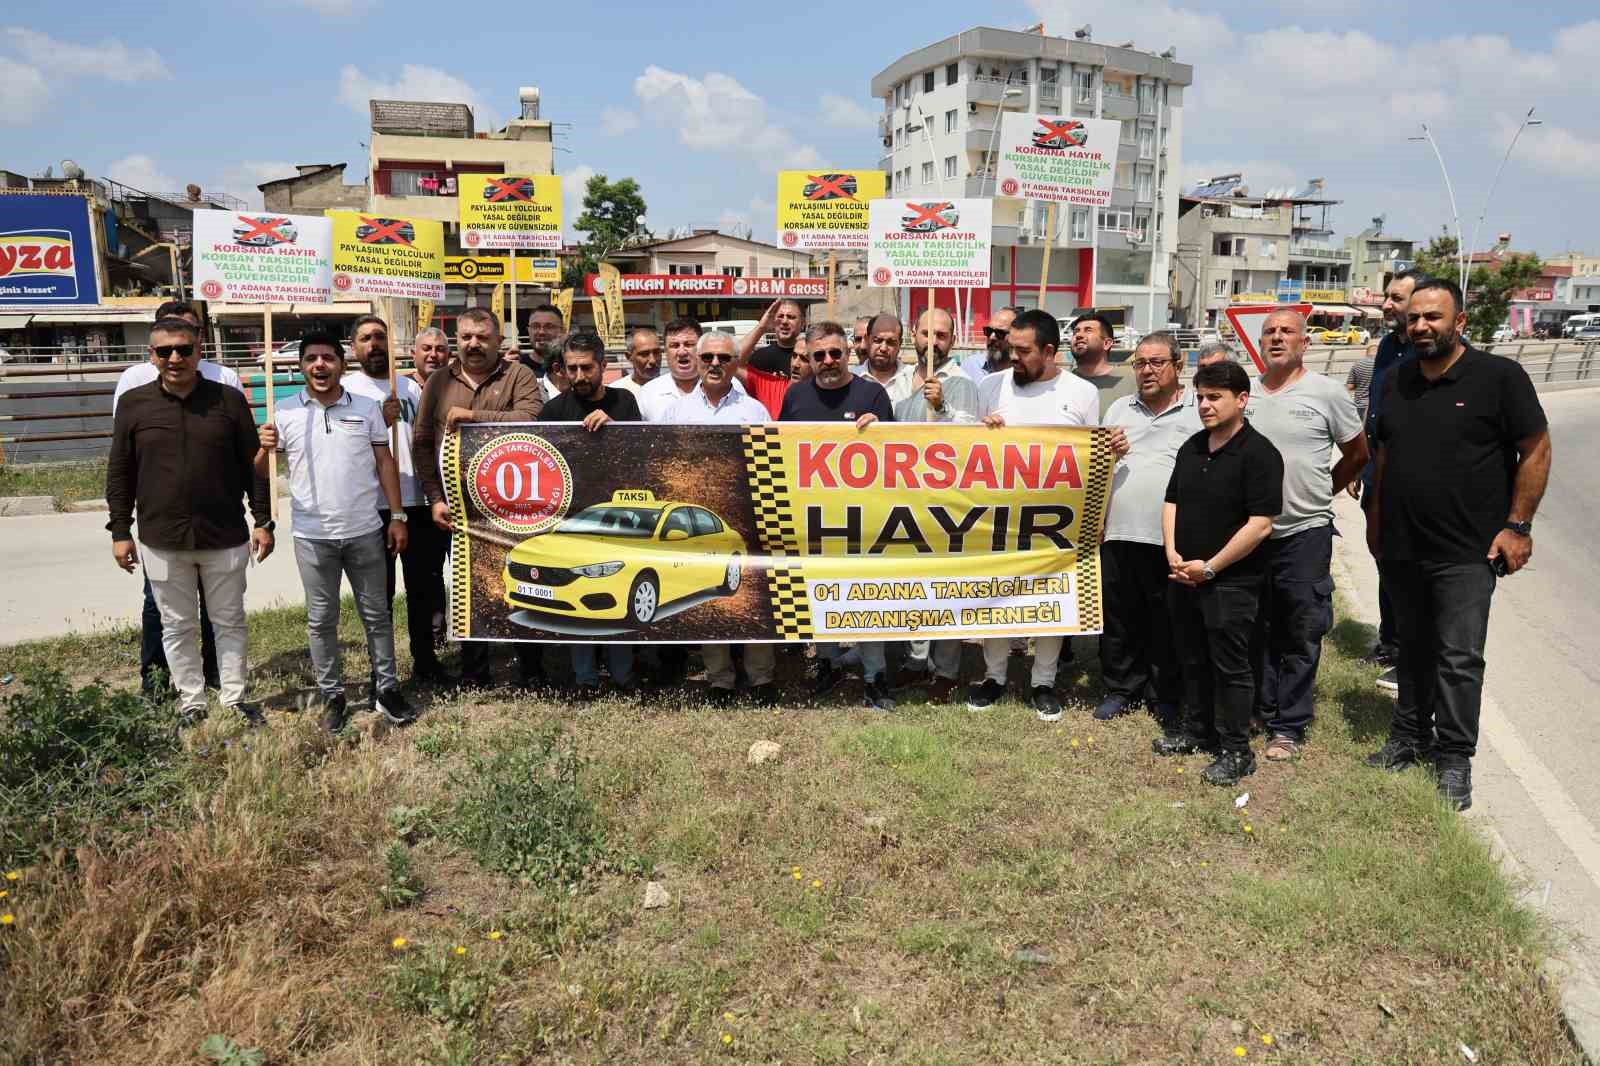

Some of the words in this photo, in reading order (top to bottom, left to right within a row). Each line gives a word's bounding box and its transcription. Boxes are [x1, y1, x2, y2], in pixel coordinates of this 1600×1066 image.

[1016, 146, 1065, 157] KORSANA
[1069, 151, 1102, 160] HAYIR
[1005, 154, 1047, 165] KORSAN
[1014, 163, 1045, 172] YASAL
[1034, 184, 1059, 193] ADANA
[829, 221, 869, 230] GÜVENSİZ
[214, 244, 274, 255] KORSANA
[280, 248, 316, 256] HAYIR
[340, 244, 389, 255] PAYLAŞIMLI
[392, 249, 435, 259] YOLCULUK
[202, 253, 254, 262] KORSAN
[355, 256, 382, 264] YASAL
[214, 262, 252, 272] YASAL
[335, 264, 370, 273] KORSAN
[386, 268, 440, 279] GÜVENSİZDİR
[668, 279, 724, 291] MARKET
[789, 284, 824, 294] GROSS
[480, 449, 504, 476] ADANA
[798, 442, 1084, 490] KORSANA
[496, 460, 545, 502] 01
[806, 505, 1076, 555] HAYIR
[518, 585, 526, 594] 01
[535, 588, 552, 598] 0001
[814, 584, 840, 601] 01
[847, 582, 926, 601] ADANA
[931, 573, 1070, 600] TAKSİCİLERİ
[826, 609, 955, 631] DAYANIŞMA
[960, 602, 1060, 627] DERNEĞİ
